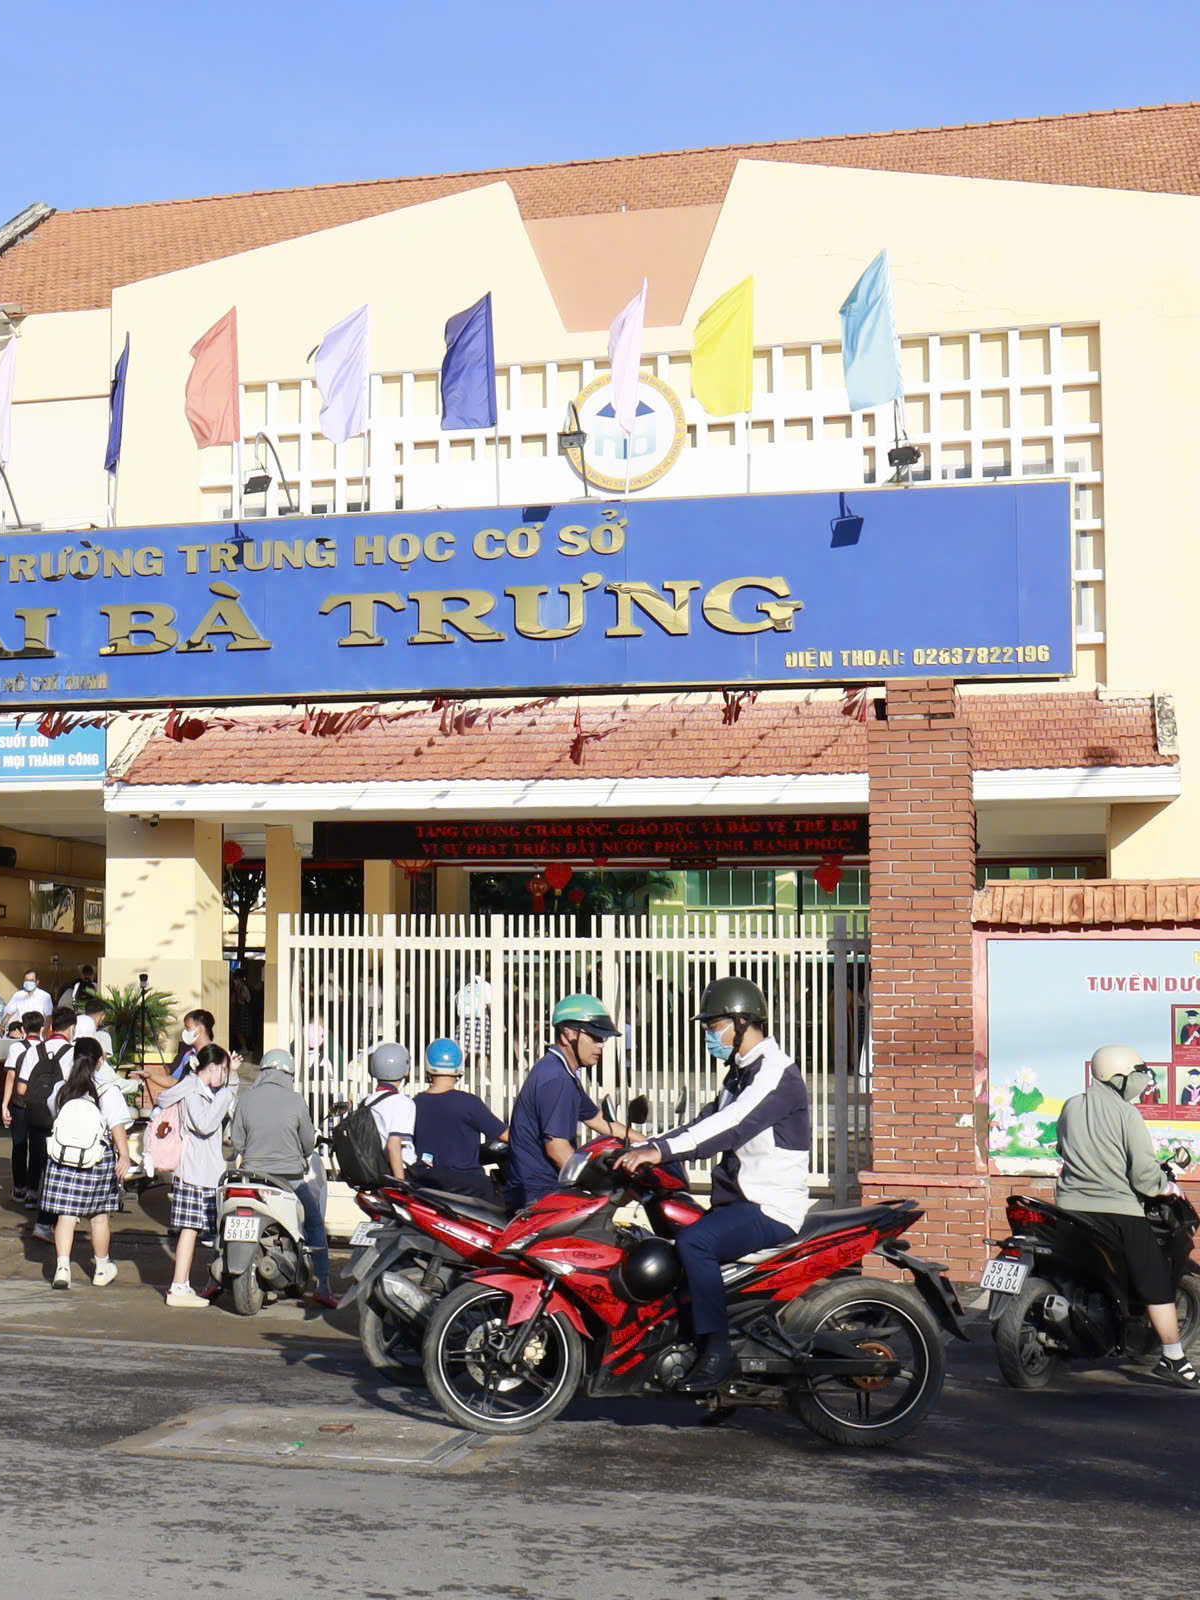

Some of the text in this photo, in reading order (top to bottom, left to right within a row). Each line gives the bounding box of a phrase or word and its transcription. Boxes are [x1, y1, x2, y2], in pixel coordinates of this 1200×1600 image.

[178, 539, 337, 575] TRUNG
[354, 531, 456, 570] HỌC
[472, 522, 544, 559] CƠ
[557, 509, 628, 556] SỞ
[99, 581, 272, 656] BÀ
[319, 572, 803, 647] TRƯNG
[785, 648, 832, 672] ĐIỆN
[913, 645, 1050, 666] 02837822196
[2, 754, 25, 770] MỌI
[28, 751, 65, 767] THÀNH
[68, 751, 100, 767] CÔNG
[831, 819, 859, 832] EM
[1087, 972, 1157, 992] TUYÊN
[230, 1218, 255, 1229] 59-Z1
[990, 1261, 1020, 1278] 59-ZA
